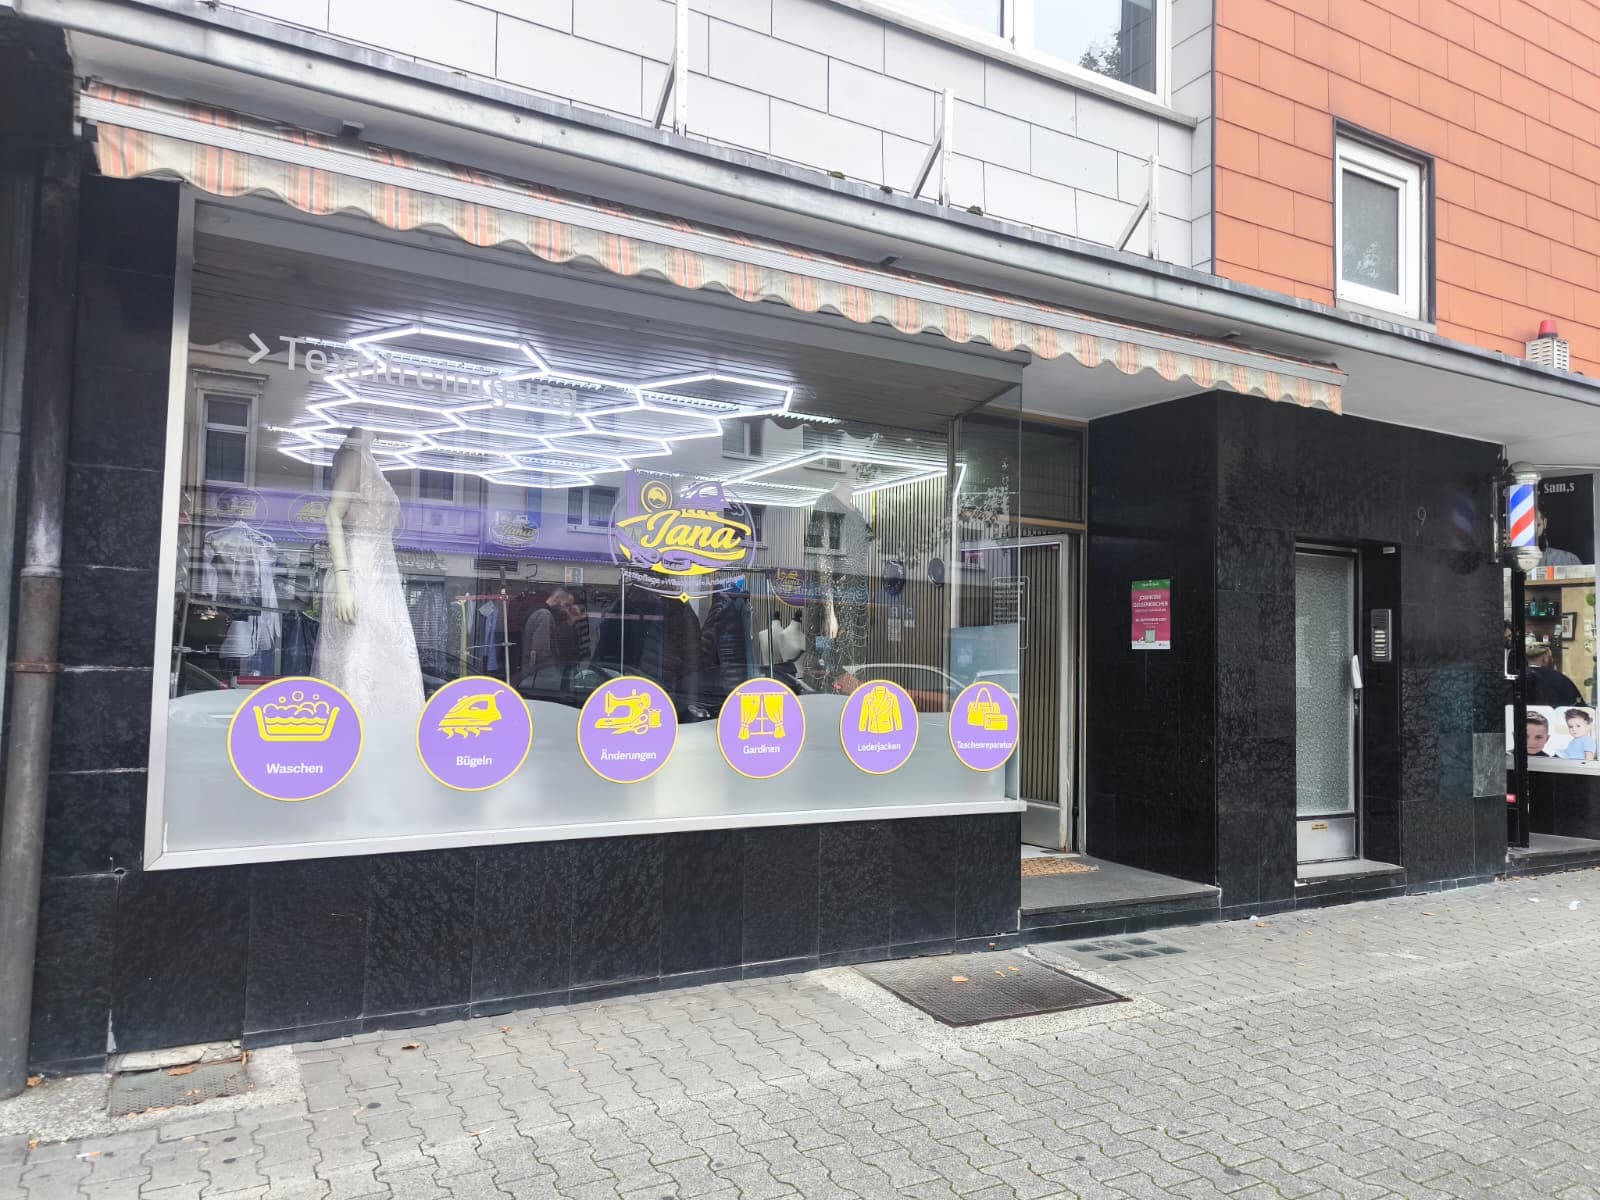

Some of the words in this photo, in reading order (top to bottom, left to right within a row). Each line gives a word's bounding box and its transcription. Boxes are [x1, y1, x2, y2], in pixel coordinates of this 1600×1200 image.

[640, 509, 742, 549] Jana
[743, 744, 781, 755] Gardinen
[857, 741, 902, 753] Lederjacken
[957, 740, 1014, 750] Taschenreparatur
[455, 754, 493, 768] Bügeln
[600, 748, 657, 762] Änderungen
[265, 762, 324, 775] Waschen
